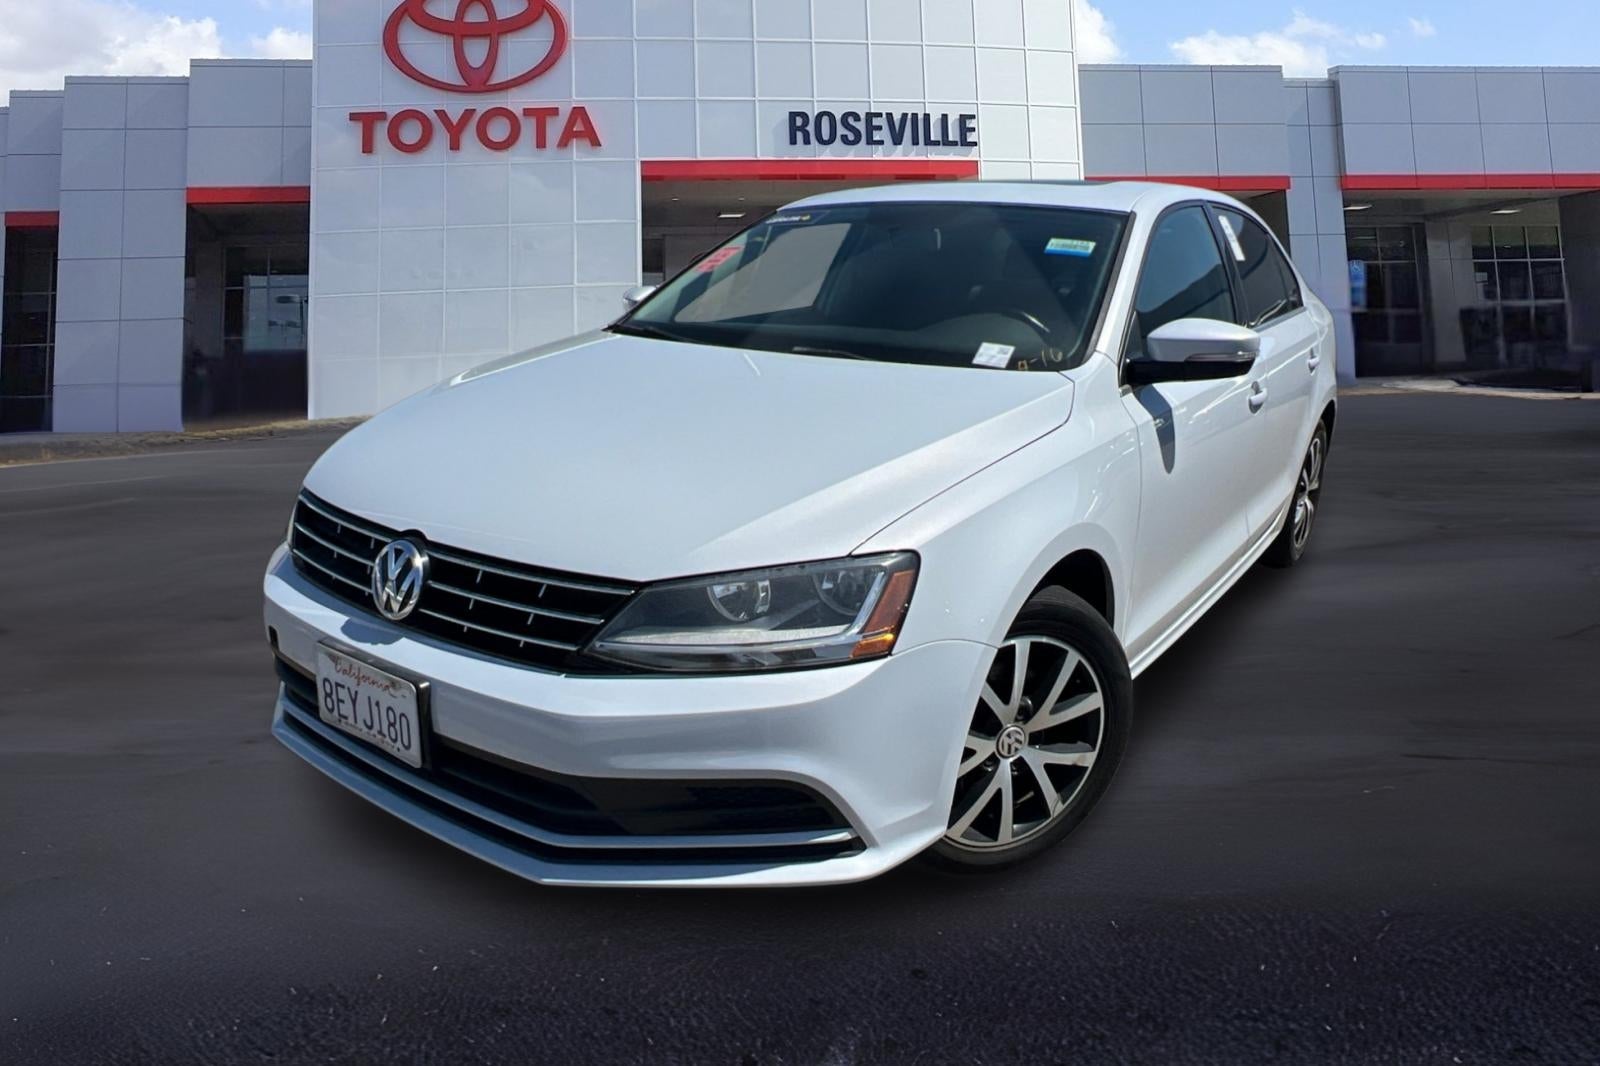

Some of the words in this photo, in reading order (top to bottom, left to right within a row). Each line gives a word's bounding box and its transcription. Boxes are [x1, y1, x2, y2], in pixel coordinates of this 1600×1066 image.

[349, 106, 602, 154] TOYOTA
[788, 111, 978, 147] ROSEVILLE
[333, 656, 393, 691] California
[322, 677, 412, 751] 8EYJ180
